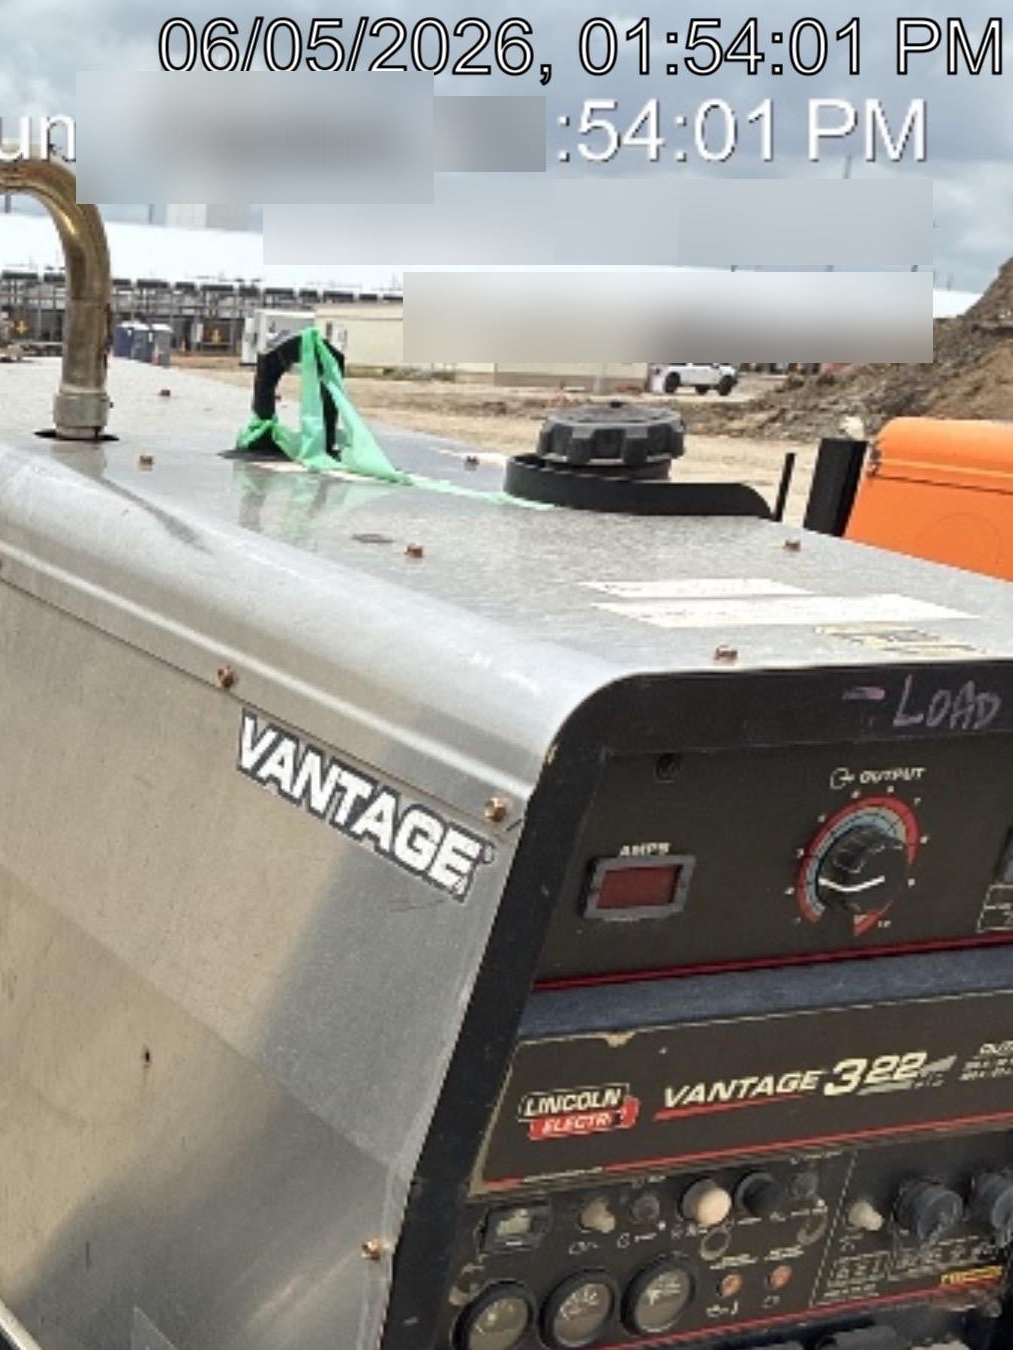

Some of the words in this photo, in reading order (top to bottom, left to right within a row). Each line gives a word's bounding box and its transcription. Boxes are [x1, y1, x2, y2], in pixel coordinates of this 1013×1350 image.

[892, 673, 1002, 731] LOAD
[859, 766, 927, 784] OUTPUT
[237, 706, 485, 903] VANTAGE
[619, 841, 672, 857] AMPS
[523, 1087, 622, 1117] LINCOLN
[662, 1069, 830, 1109] VANTAGE
[540, 1108, 630, 1135] ELECTR
